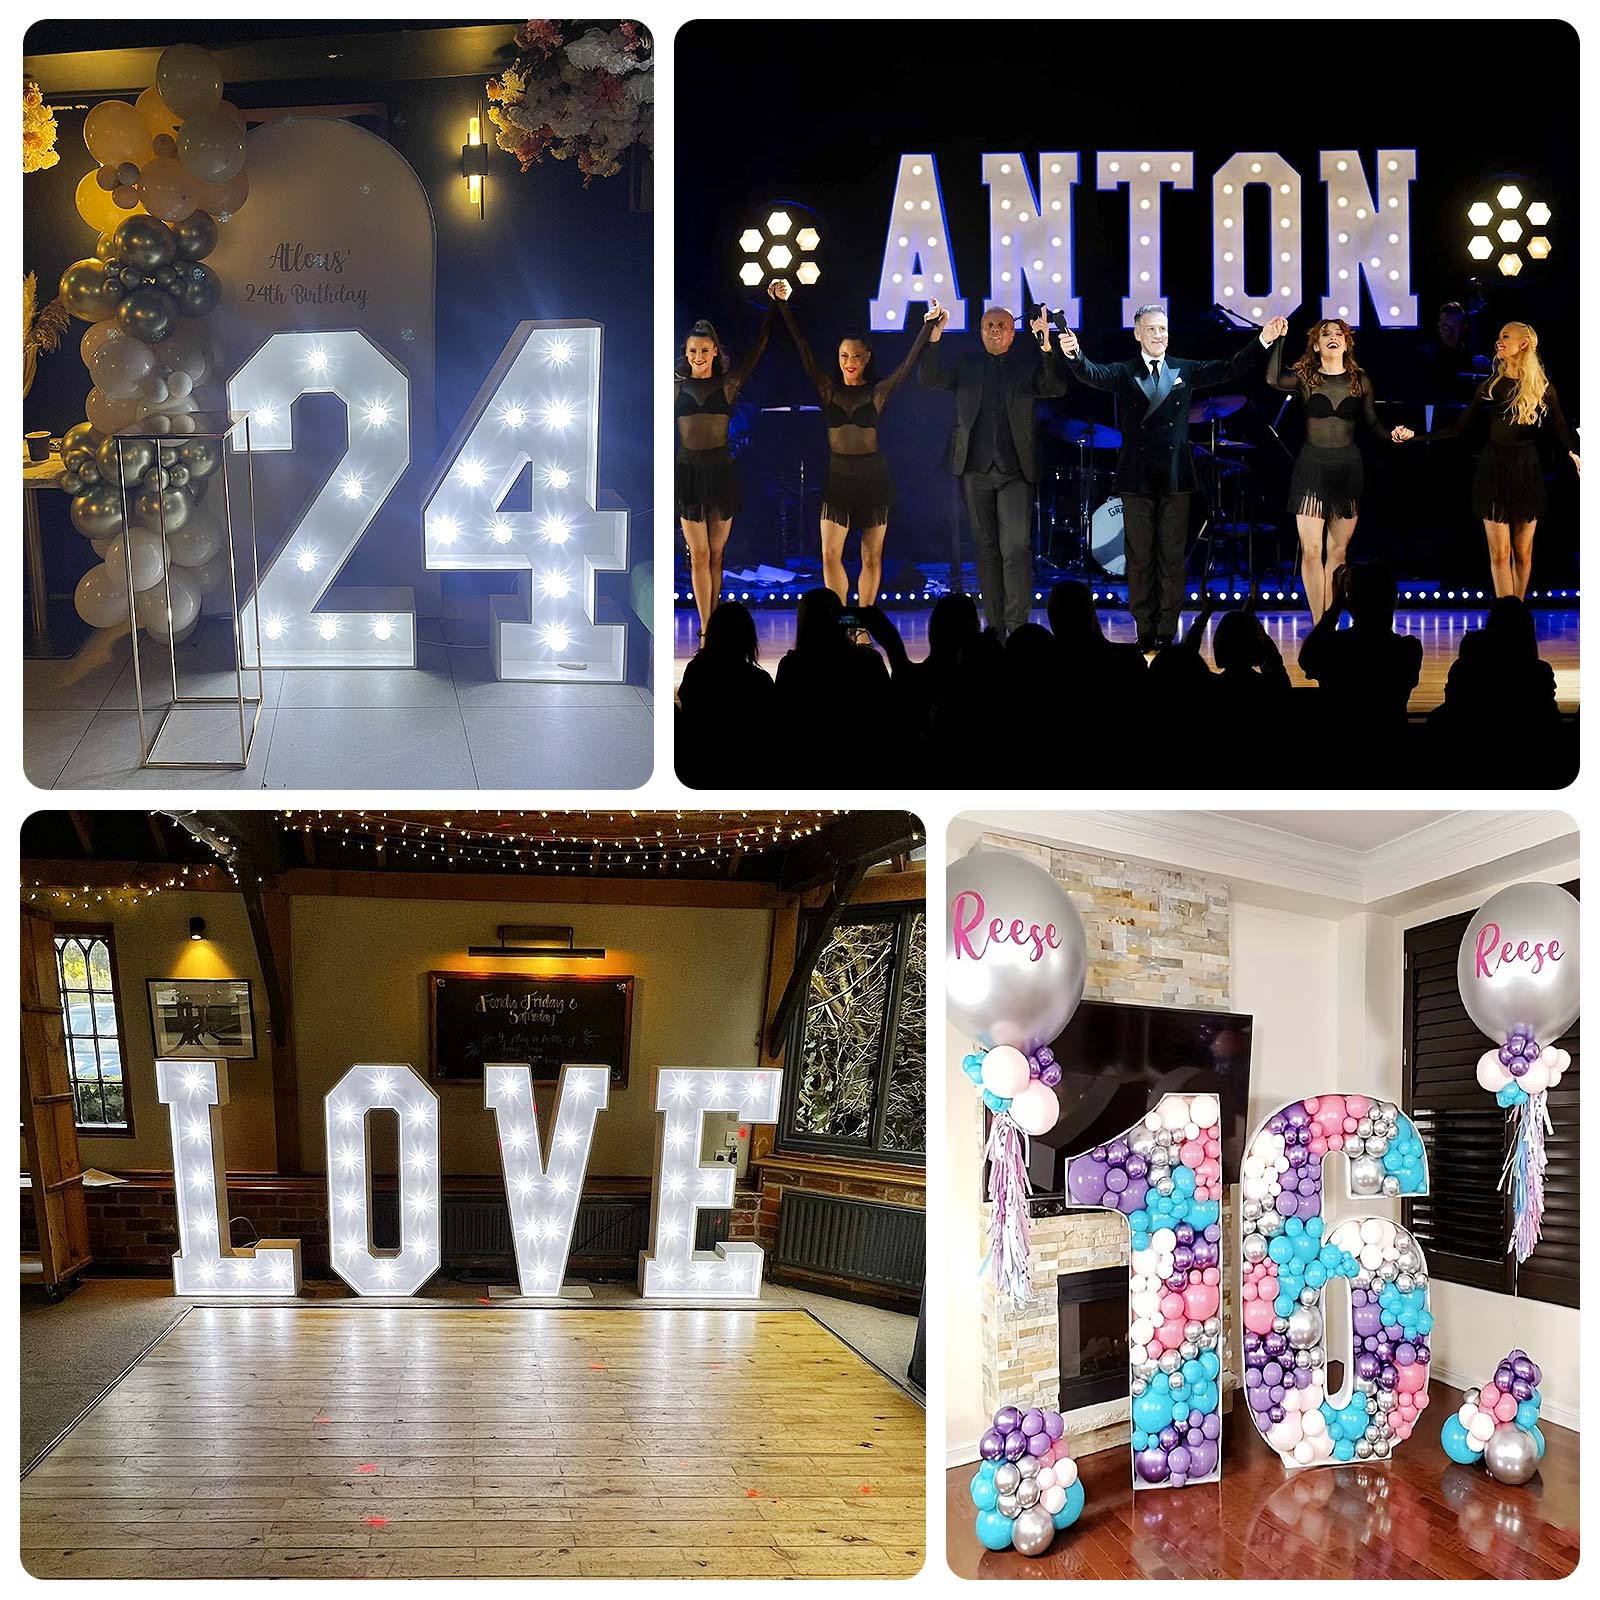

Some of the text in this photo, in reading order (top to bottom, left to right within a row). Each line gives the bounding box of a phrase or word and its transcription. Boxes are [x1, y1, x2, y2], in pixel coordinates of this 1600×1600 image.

[245, 283, 369, 310] 24th Birthday
[869, 150, 1419, 332] ANTON
[226, 319, 629, 684] 24
[951, 890, 1063, 962] Reese
[1476, 923, 1566, 978] Reese
[520, 991, 564, 1013] Friday
[155, 1059, 784, 1298] LOVE
[1065, 1092, 1434, 1490] 16
